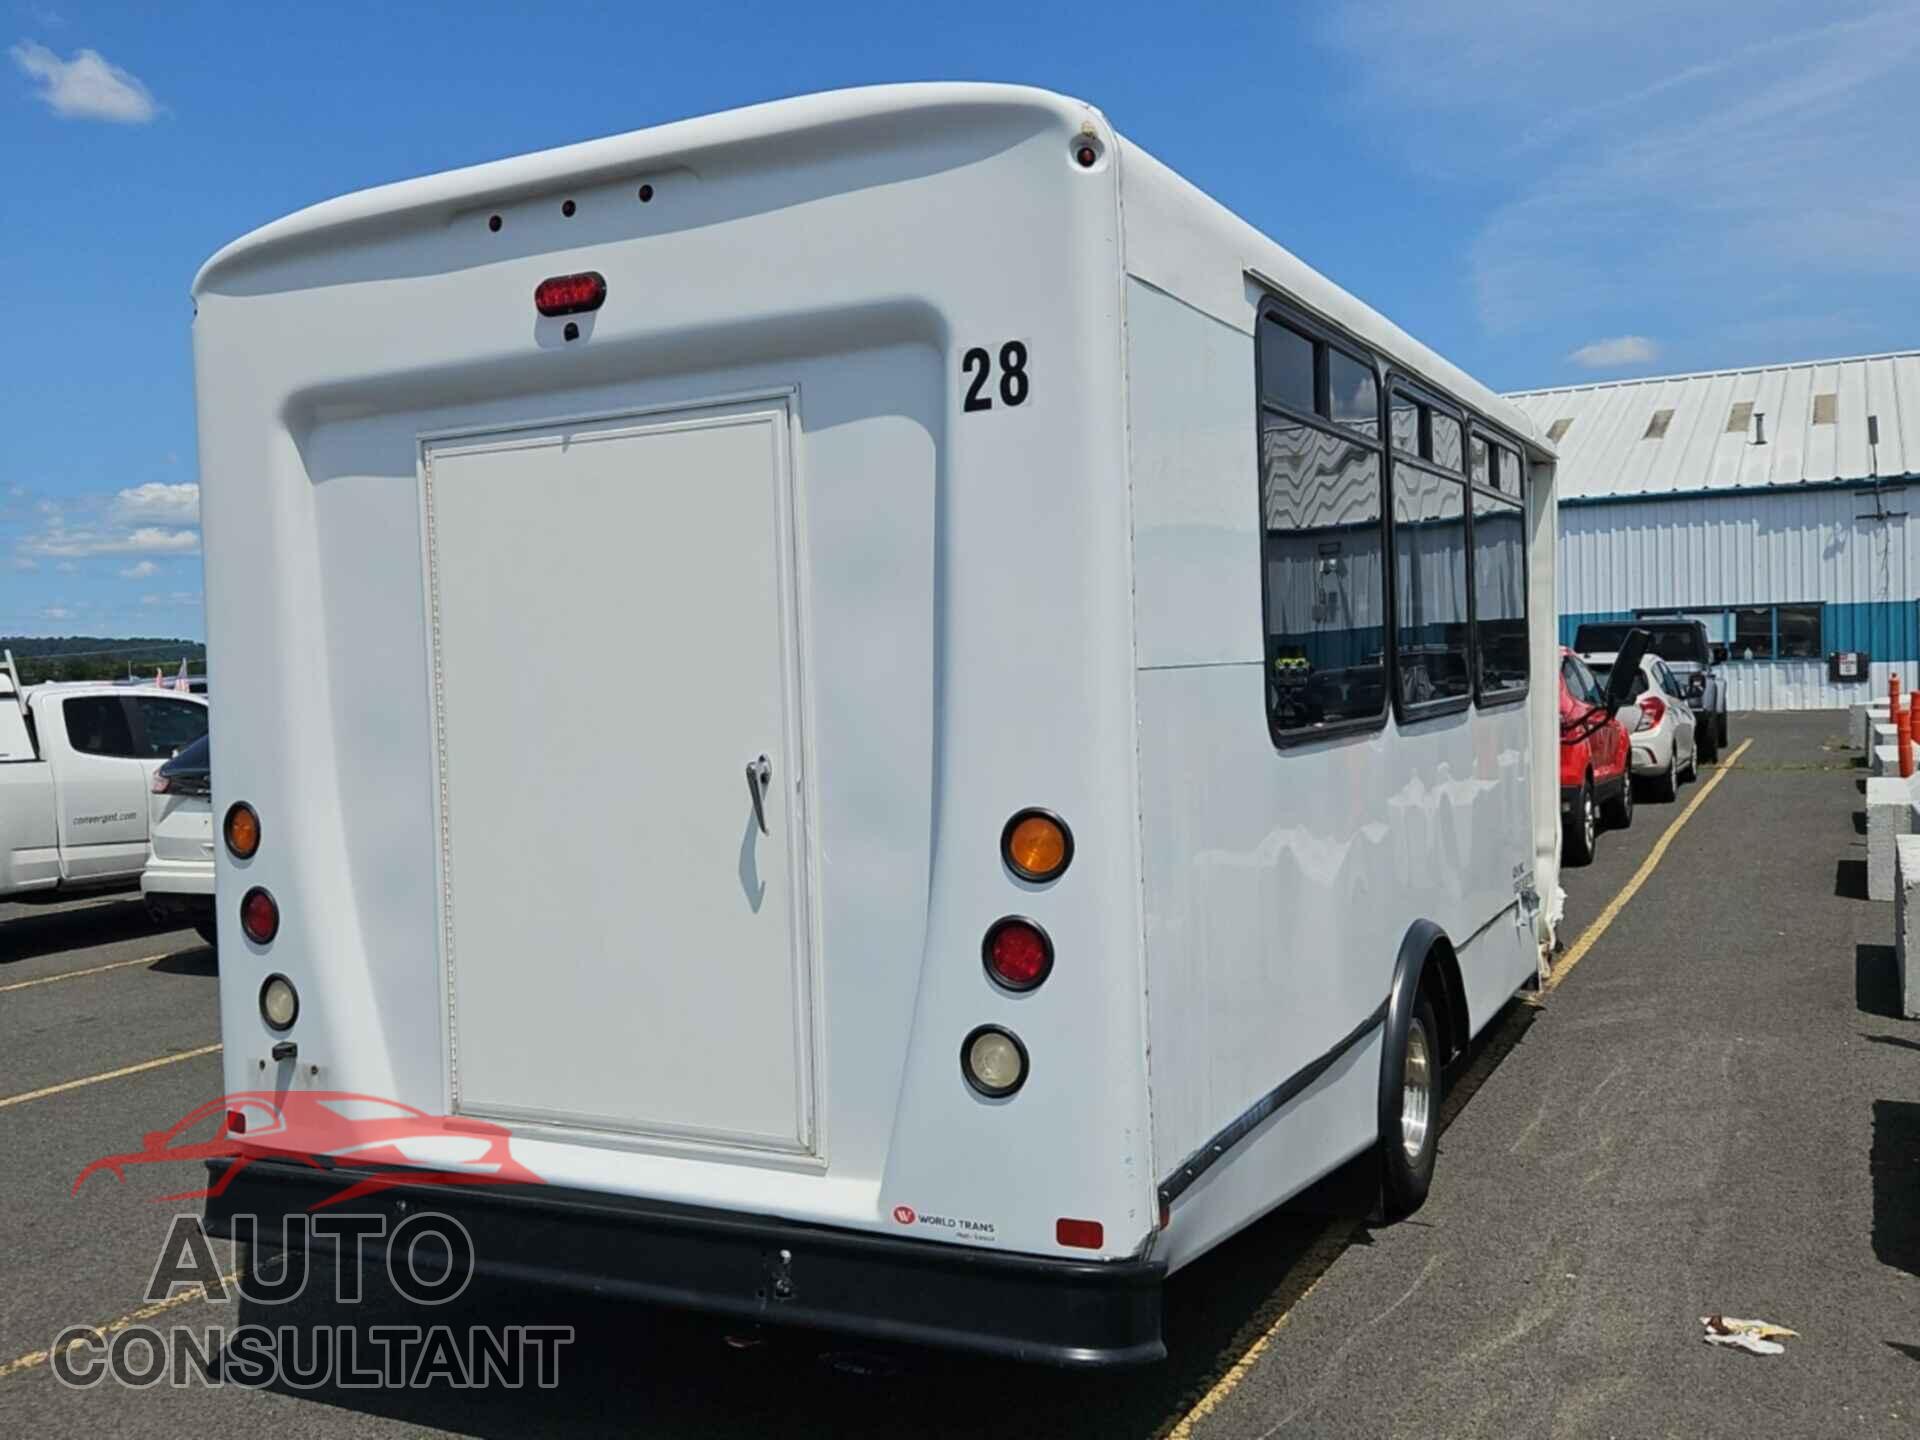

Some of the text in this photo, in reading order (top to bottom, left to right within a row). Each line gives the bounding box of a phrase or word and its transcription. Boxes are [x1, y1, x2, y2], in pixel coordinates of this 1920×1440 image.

[962, 340, 1029, 413] 28
[919, 1215, 956, 1227] WORLD
[958, 1219, 995, 1232] TRANS
